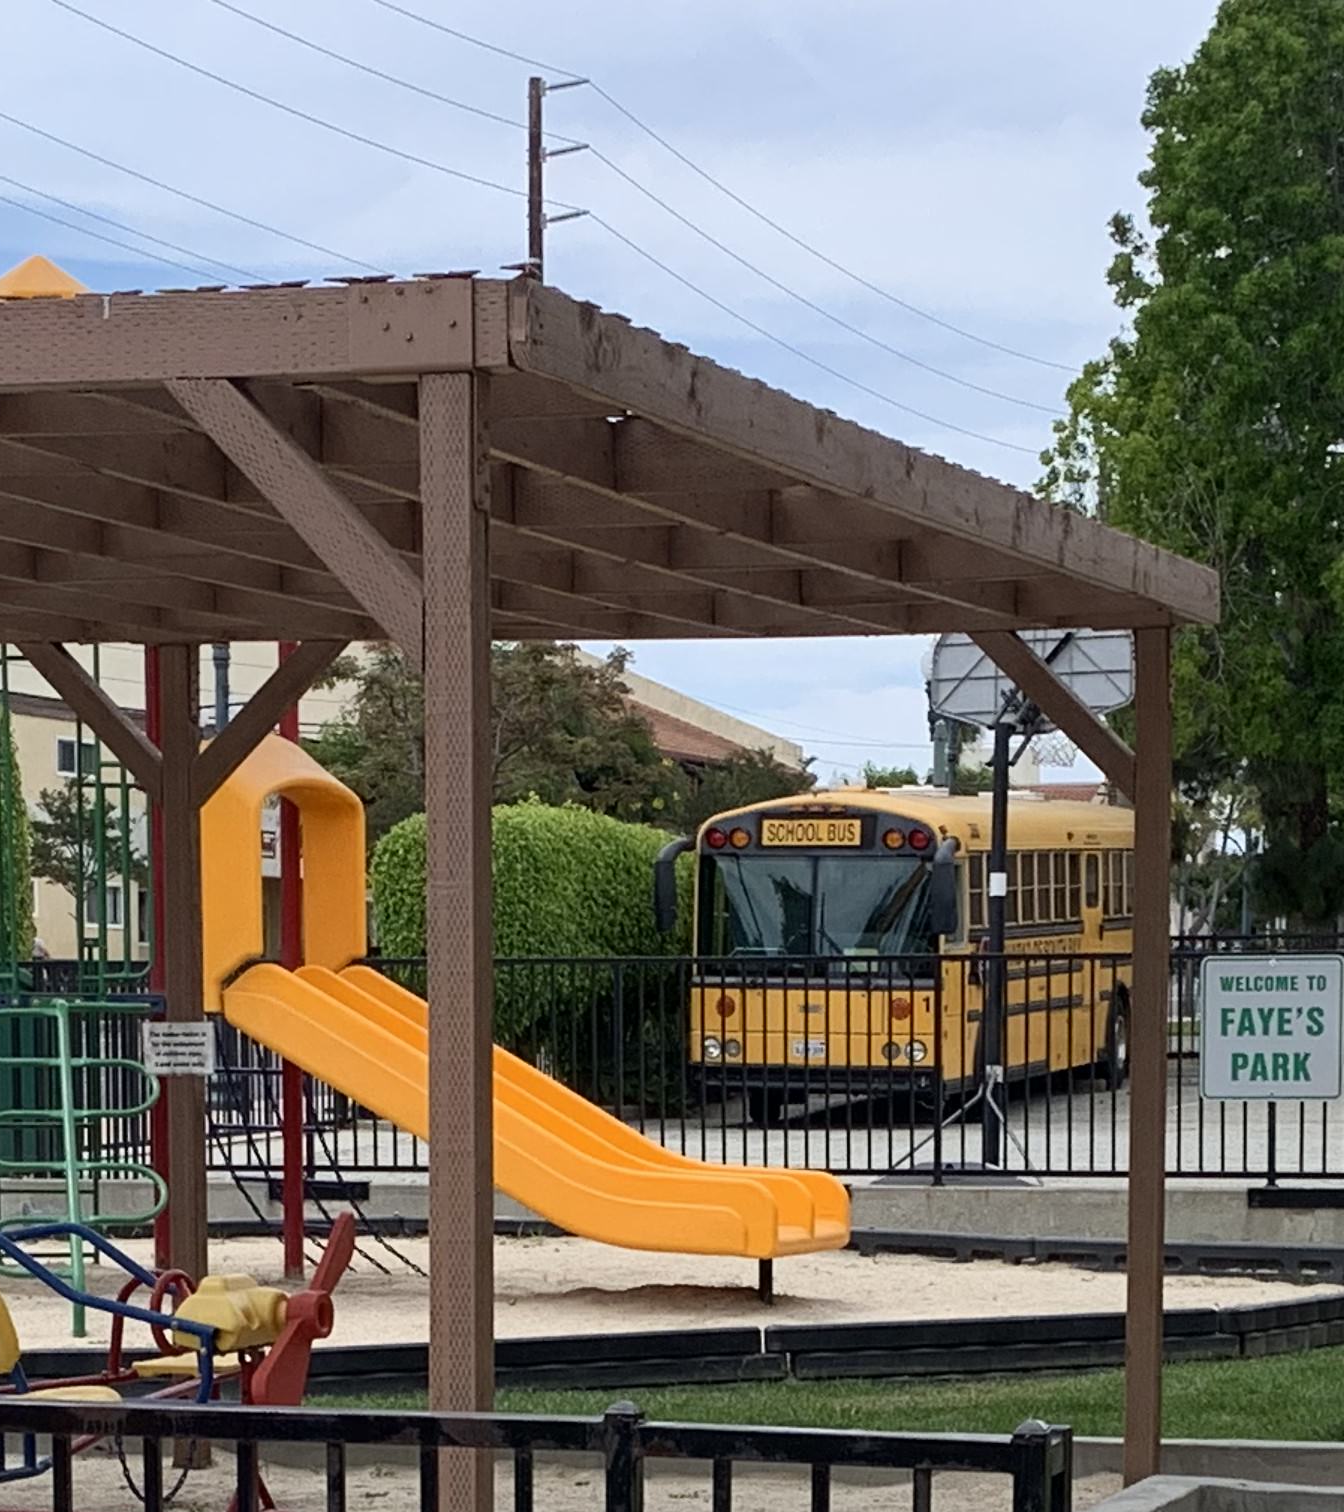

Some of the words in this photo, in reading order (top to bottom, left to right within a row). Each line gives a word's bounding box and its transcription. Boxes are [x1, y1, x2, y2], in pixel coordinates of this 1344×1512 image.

[767, 822, 823, 843] SCHOOL
[827, 822, 856, 843] BUS
[1219, 975, 1299, 993] WELCOME
[1306, 974, 1327, 992] TO
[922, 995, 930, 1014] 1
[1220, 1006, 1325, 1037] FAYE'S
[1231, 1052, 1312, 1082] PARK
